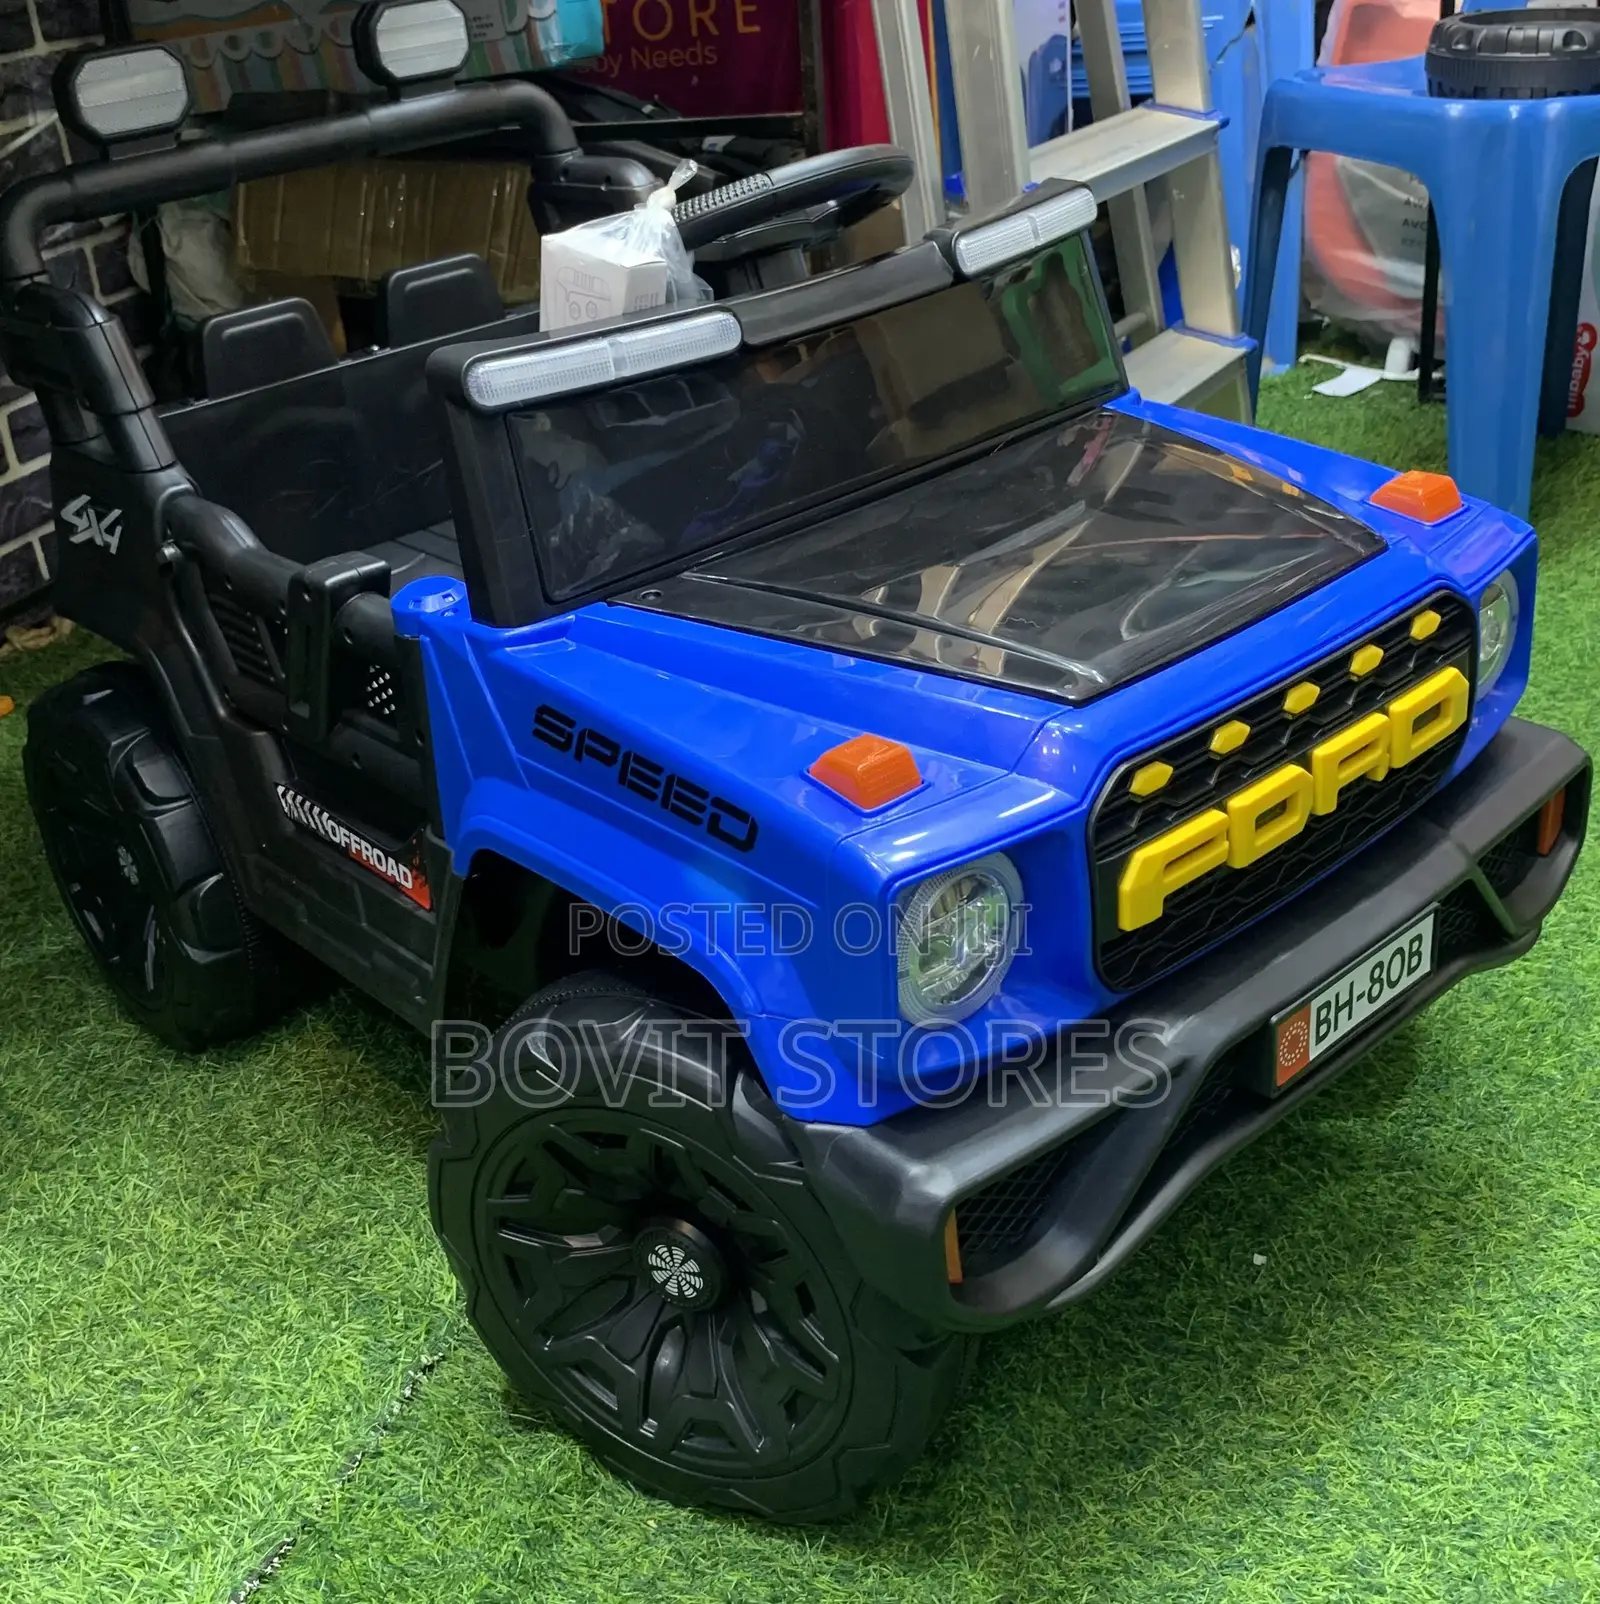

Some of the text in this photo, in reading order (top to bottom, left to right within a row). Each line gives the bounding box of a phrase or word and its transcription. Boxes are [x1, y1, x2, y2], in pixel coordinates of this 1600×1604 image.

[630, 40, 718, 71] Needs
[532, 703, 759, 853] SPEED
[327, 819, 414, 889] OFFROAD
